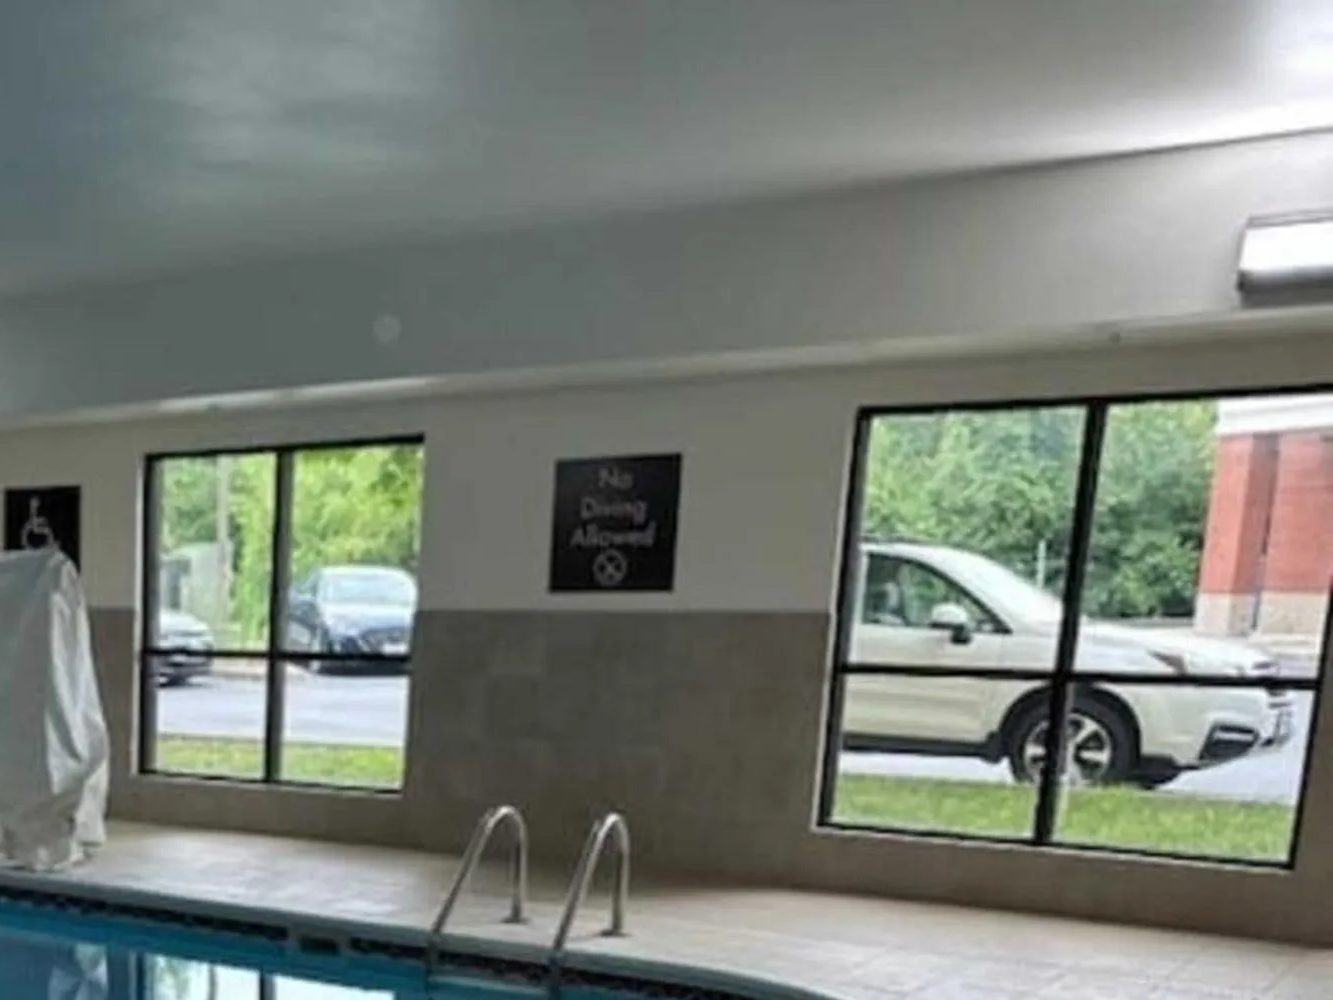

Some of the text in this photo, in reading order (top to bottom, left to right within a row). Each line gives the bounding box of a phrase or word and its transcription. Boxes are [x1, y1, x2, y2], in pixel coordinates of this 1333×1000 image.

[597, 465, 634, 490] No
[580, 497, 648, 525] Diving
[569, 520, 657, 548] Allowed
